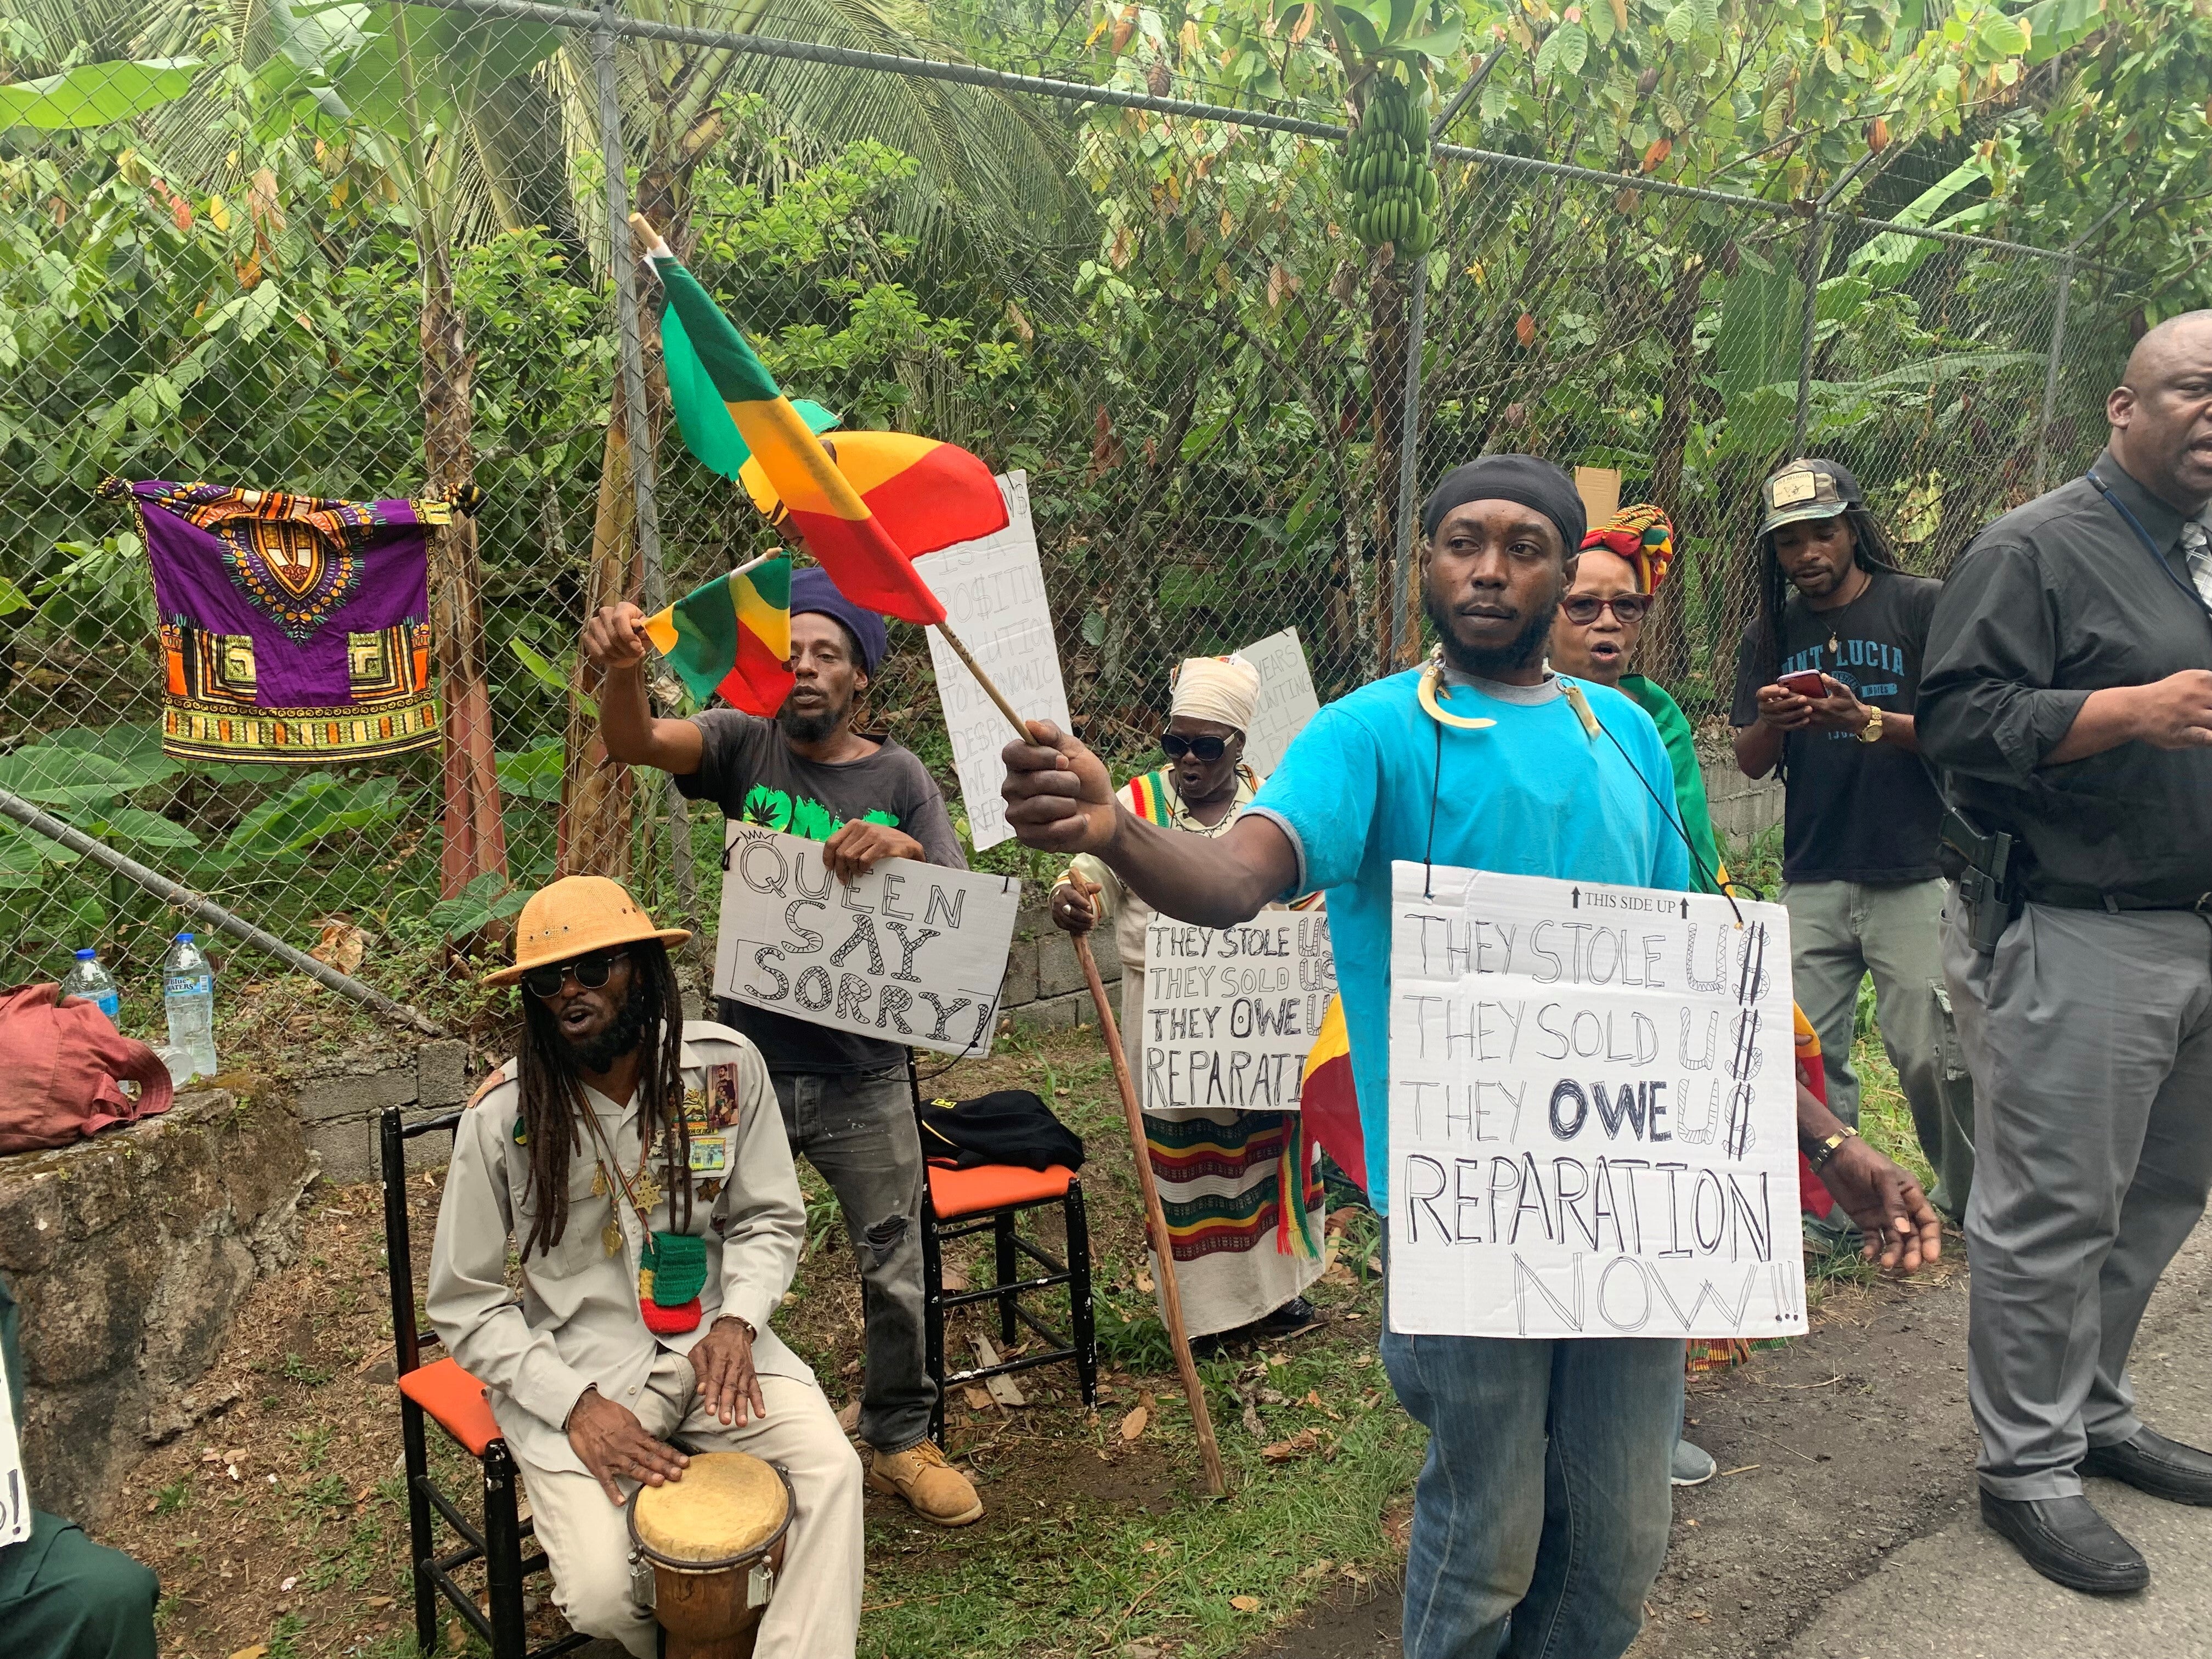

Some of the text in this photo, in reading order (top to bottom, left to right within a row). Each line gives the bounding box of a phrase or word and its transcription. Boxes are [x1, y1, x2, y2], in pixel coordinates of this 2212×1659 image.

[1836, 640, 1905, 676] LUCIA
[940, 683, 968, 718] TO
[1246, 707, 1305, 747] ILL
[961, 759, 991, 798] WE
[740, 840, 966, 929] QUEEN
[1584, 891, 1676, 914] THIS SIDE UP
[781, 900, 940, 983] SAY
[1149, 927, 1214, 958] THEY
[1217, 927, 1290, 958] STOLE
[1404, 914, 1516, 975] THEY
[1531, 920, 1667, 988] STOLE
[166, 983, 194, 991] WATERS
[744, 946, 989, 1048] SORRY!
[1150, 966, 1216, 1000] THEY
[1221, 967, 1289, 998] SOLD
[1148, 1006, 1222, 1042] THEY
[1231, 997, 1301, 1038] OWE
[1403, 996, 1526, 1064] THEY
[1536, 1003, 1658, 1067] SOLD
[1400, 1080, 1527, 1144] THEY
[1548, 1078, 1672, 1143] OWE
[1406, 1152, 1772, 1263] REPARATION
